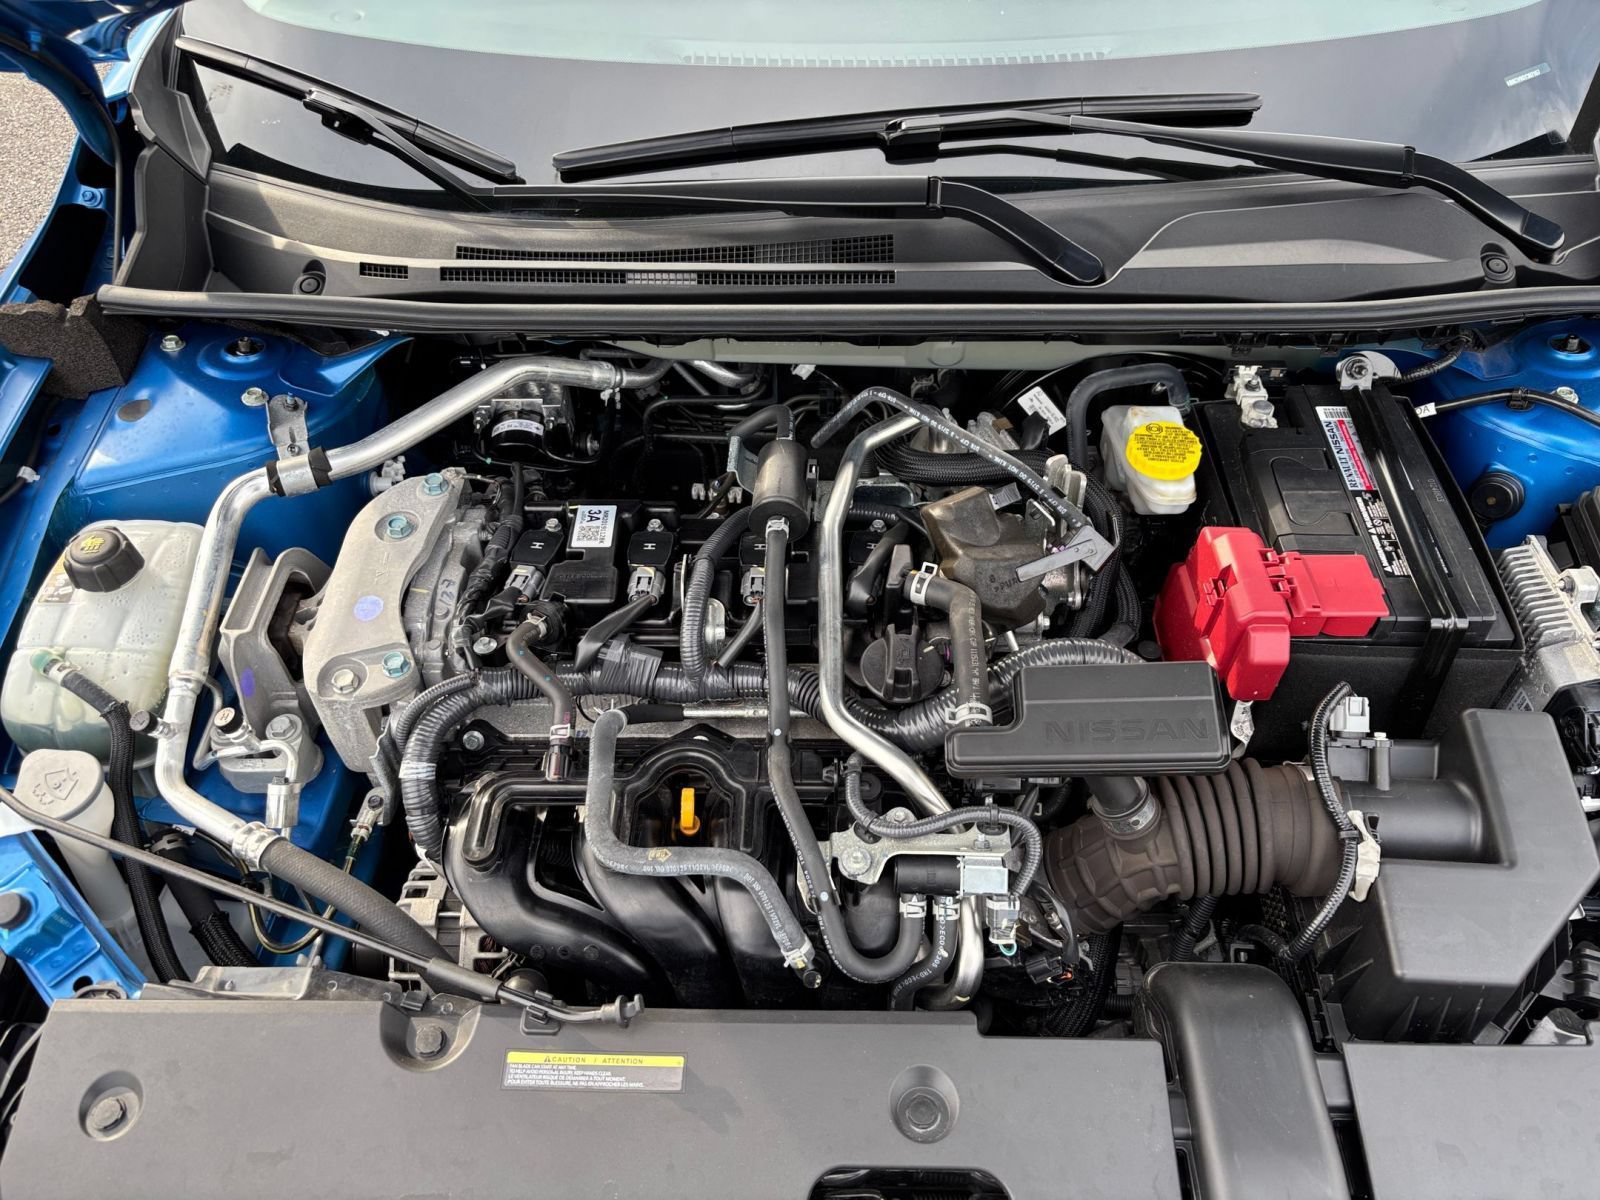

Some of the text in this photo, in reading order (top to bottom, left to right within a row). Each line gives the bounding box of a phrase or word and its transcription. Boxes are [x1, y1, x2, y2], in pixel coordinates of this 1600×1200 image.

[1324, 420, 1344, 456] NISSAN
[1340, 454, 1359, 489] RENAULT
[586, 509, 602, 523] 3A
[1042, 718, 1209, 744] NISSAN
[602, 1057, 644, 1065] ATTENTION
